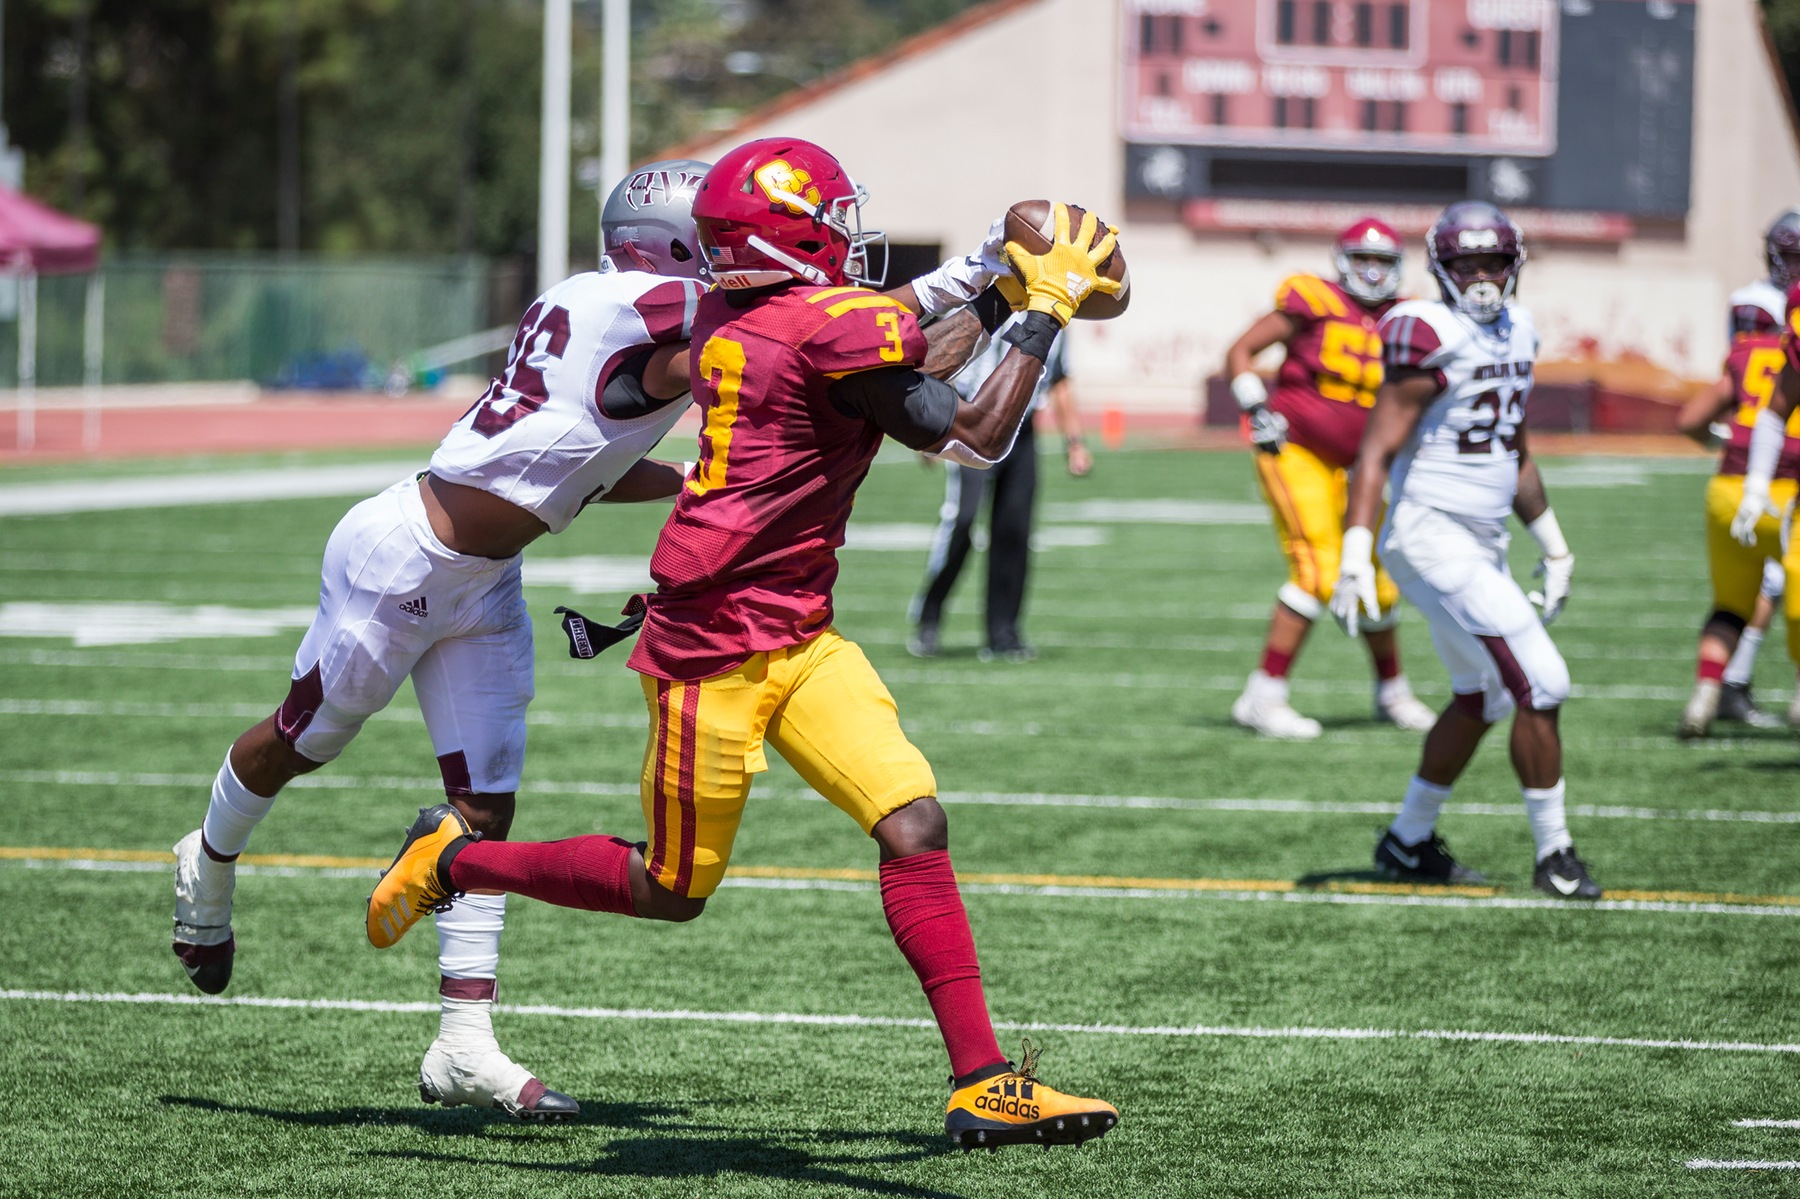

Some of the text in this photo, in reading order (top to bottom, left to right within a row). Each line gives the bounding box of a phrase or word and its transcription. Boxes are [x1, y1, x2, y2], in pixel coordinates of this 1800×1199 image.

[876, 312, 904, 363] 3
[686, 336, 746, 497] 3
[399, 603, 428, 618] adidas
[974, 1095, 1040, 1120] adidas
